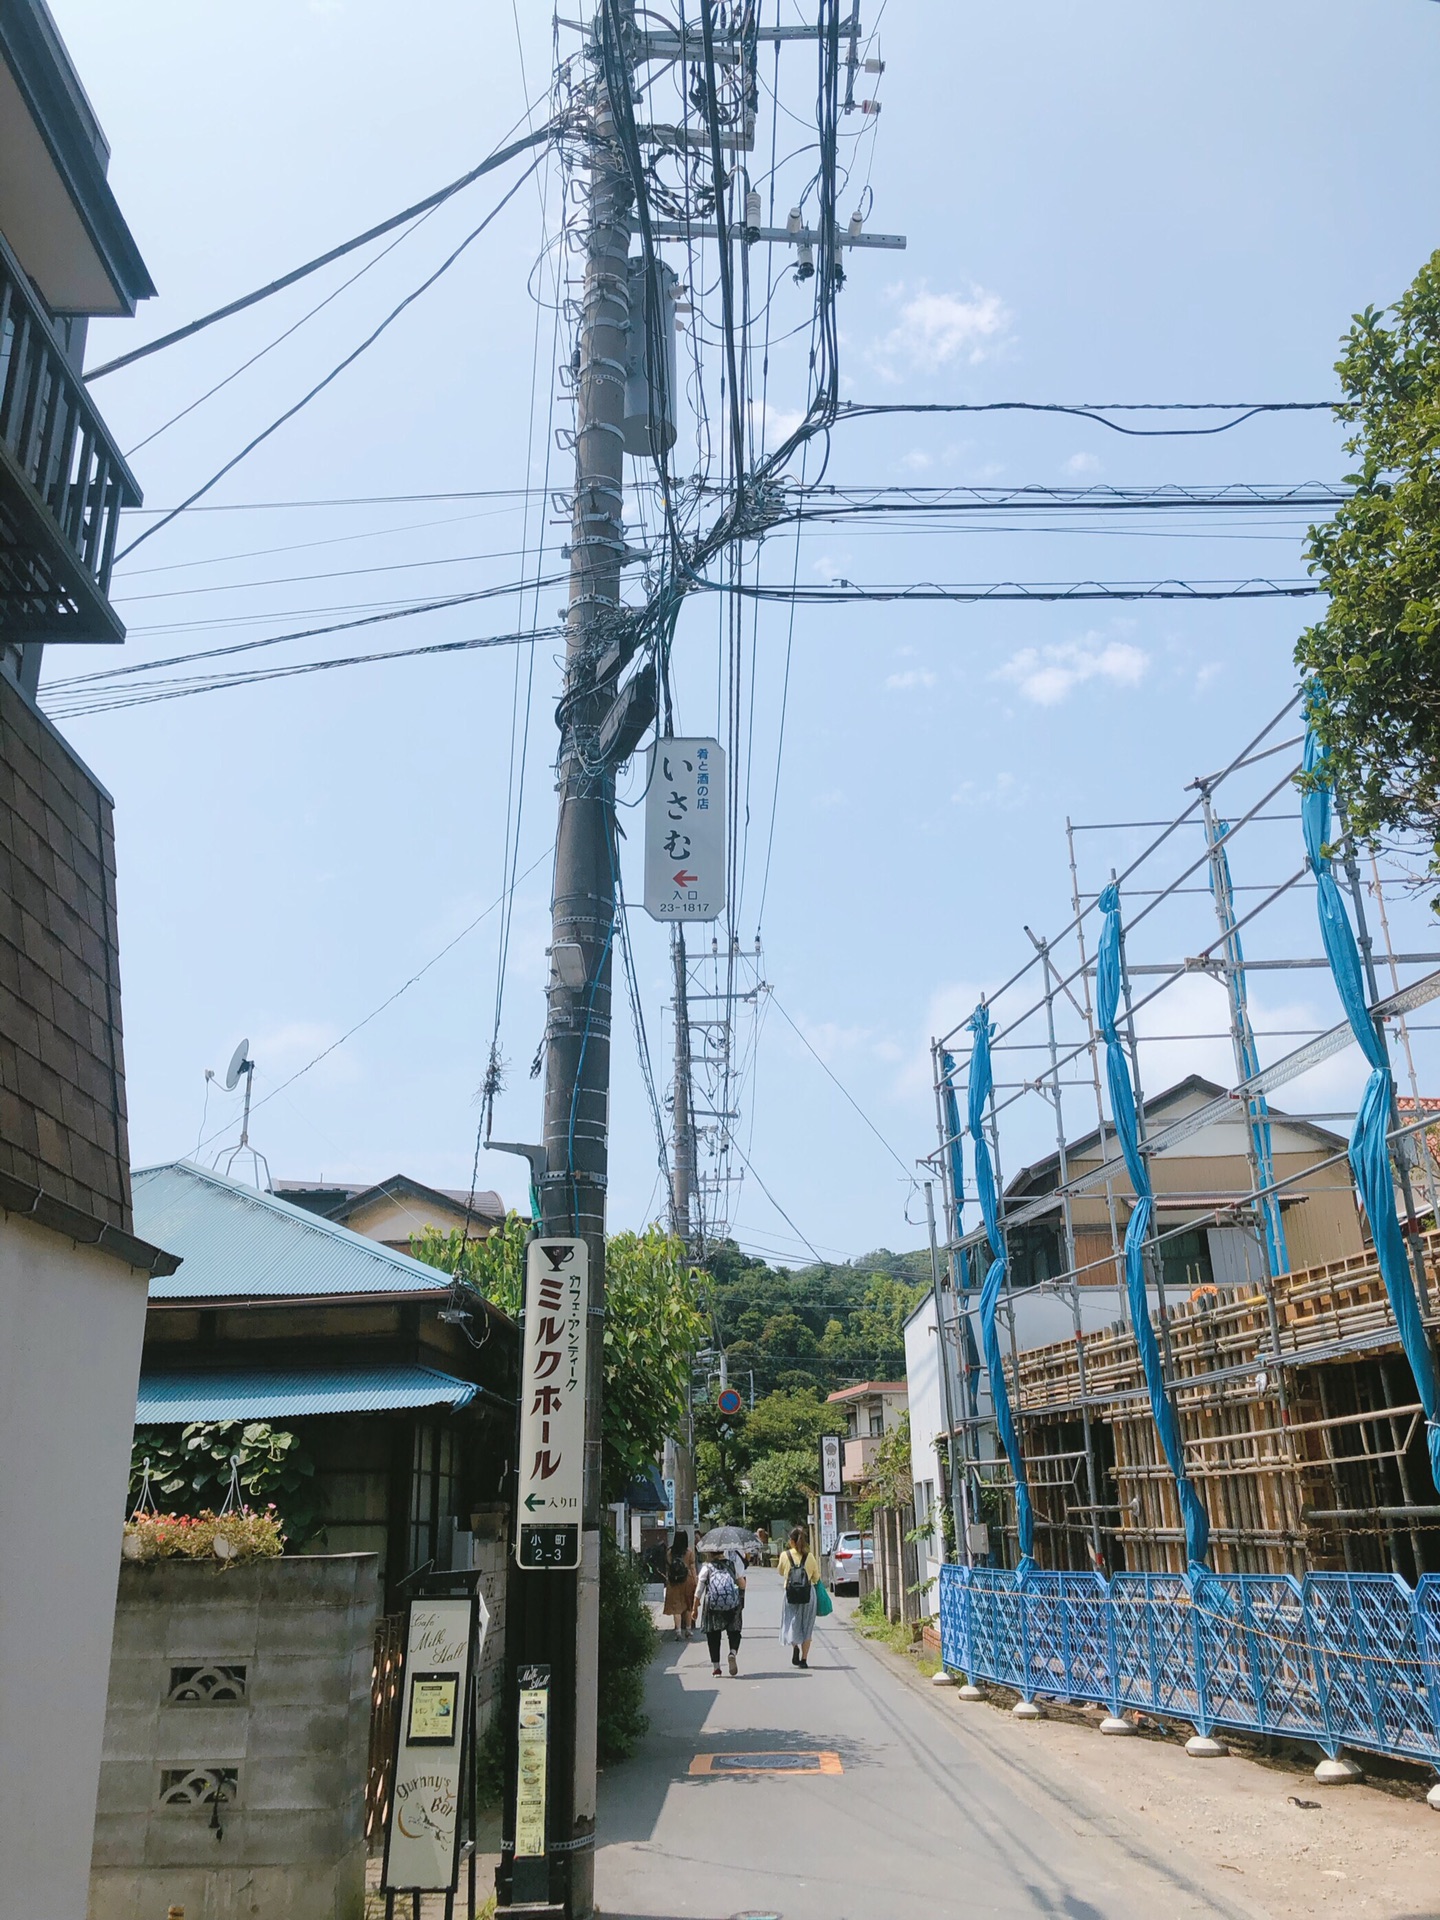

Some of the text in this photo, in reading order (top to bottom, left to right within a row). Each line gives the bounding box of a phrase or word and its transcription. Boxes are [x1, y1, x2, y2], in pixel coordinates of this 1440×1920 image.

[697, 748, 709, 810] 肴と酒の店
[663, 756, 693, 860] いさむ
[659, 903, 710, 912] 23-1817
[672, 890, 698, 900] 入口
[565, 1274, 581, 1392] カフェ・アンティーク
[530, 1278, 566, 1481] ミルクホール
[548, 1496, 577, 1509] 入り口
[535, 1548, 562, 1561] 2-3
[410, 1628, 447, 1653] Milk
[429, 1641, 467, 1666] Hall
[430, 1796, 455, 1818] Bar
